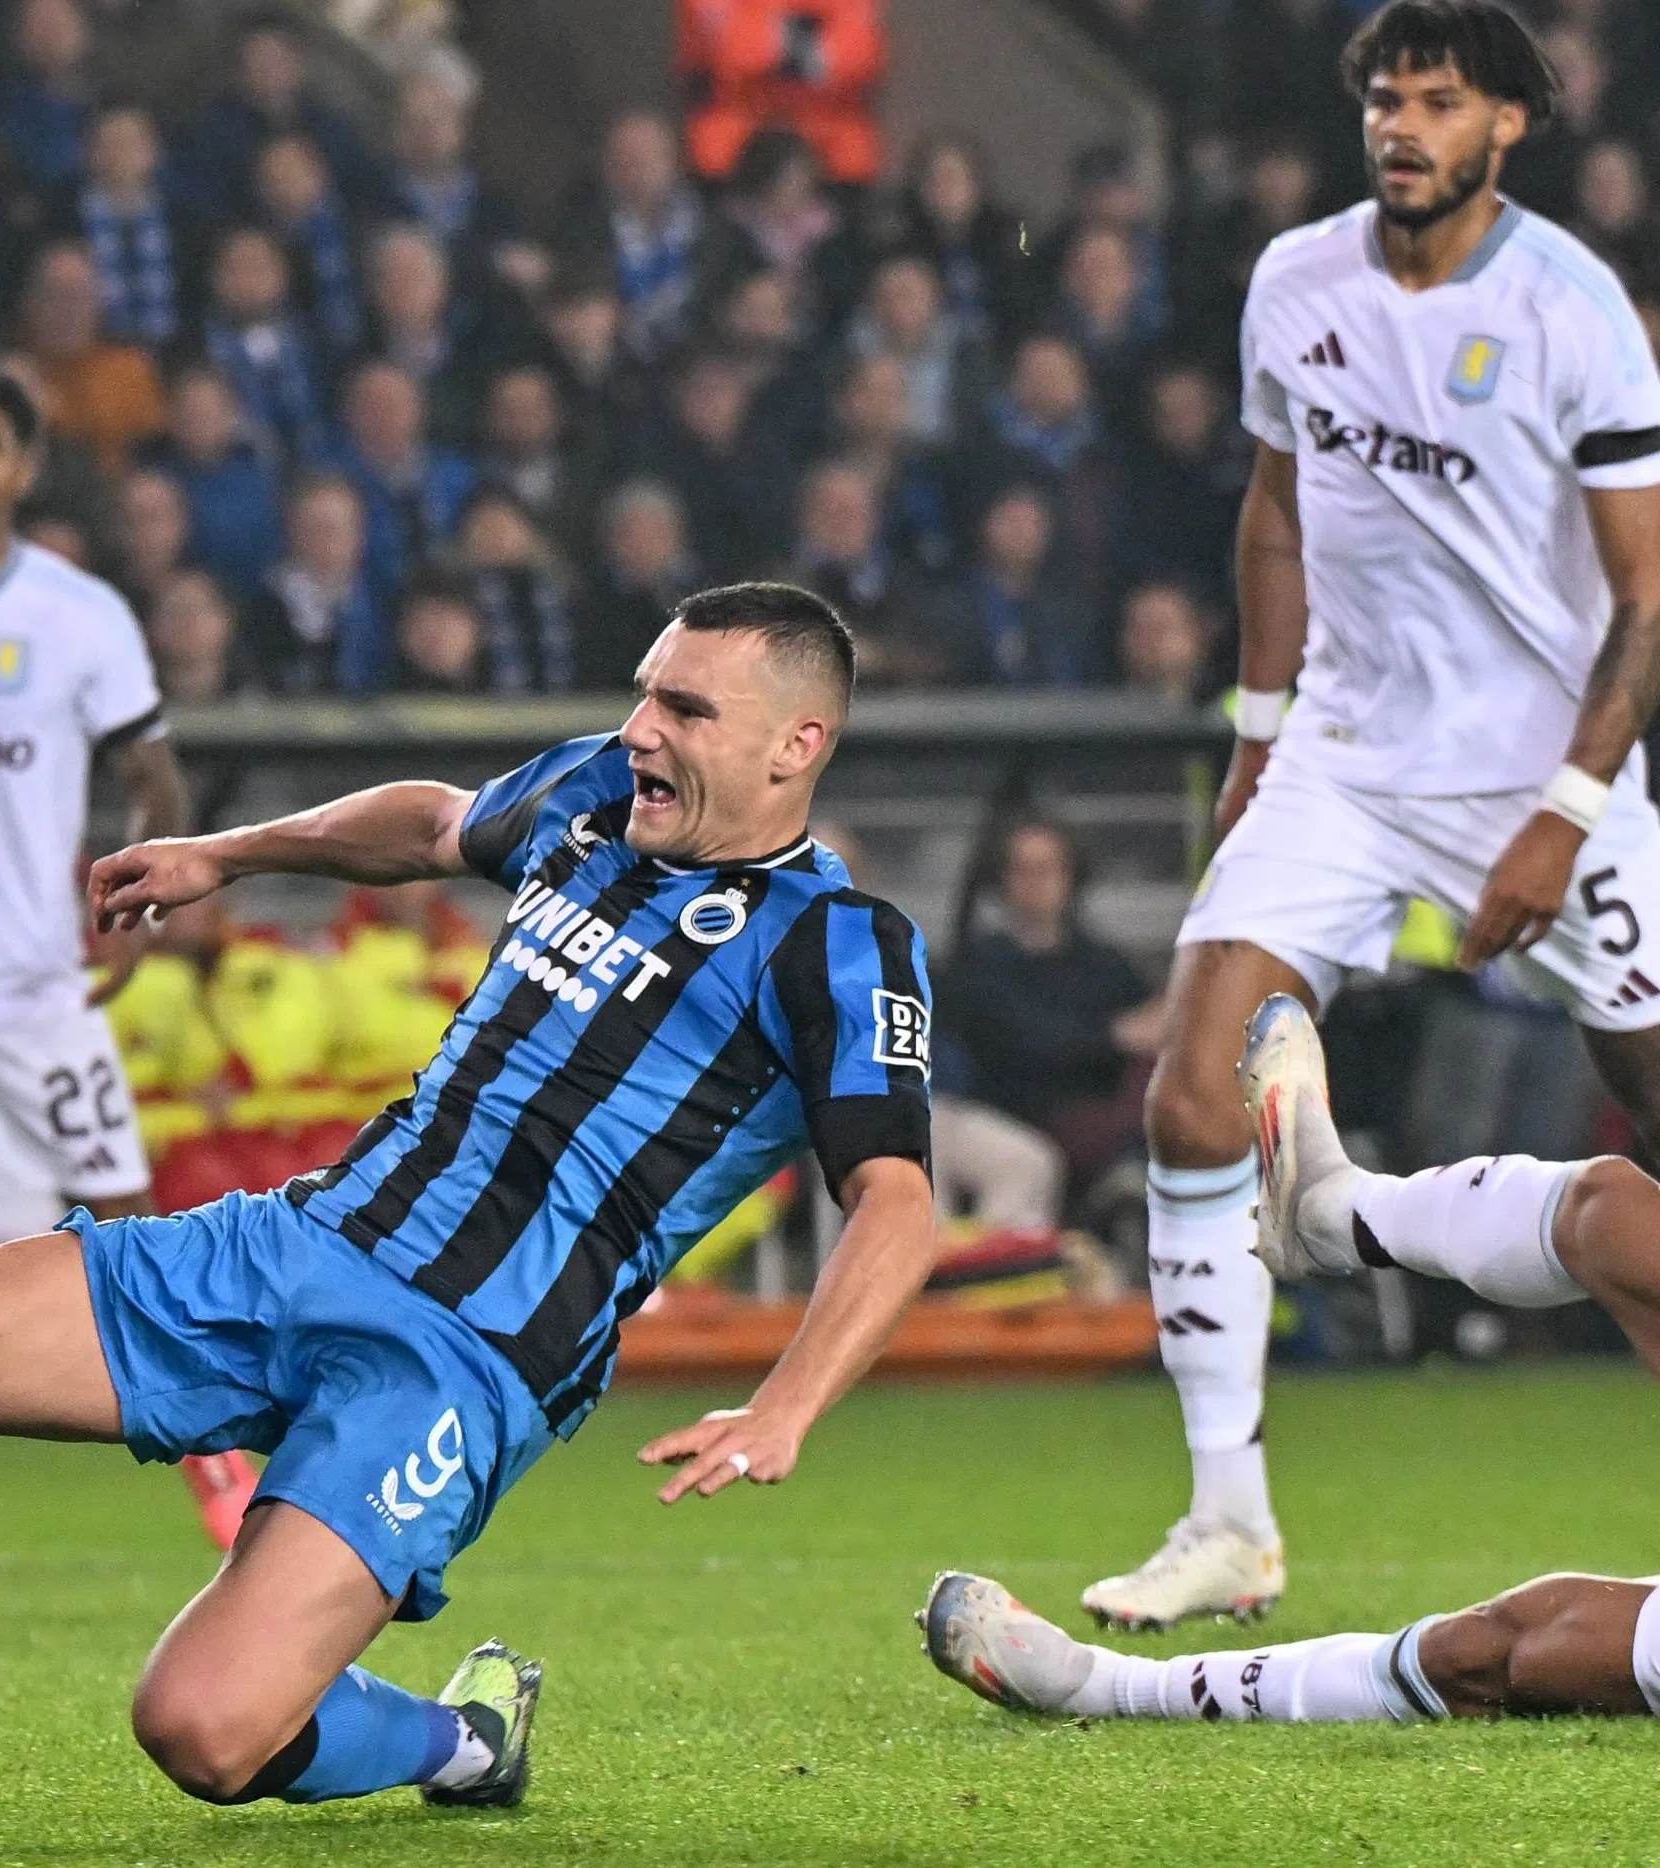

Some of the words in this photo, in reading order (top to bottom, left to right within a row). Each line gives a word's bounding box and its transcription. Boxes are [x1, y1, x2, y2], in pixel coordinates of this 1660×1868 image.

[506, 879, 672, 1003] UNIBET
[1579, 866, 1641, 957] 5
[42, 1056, 127, 1138] 22
[405, 1407, 462, 1498] 9
[1240, 1653, 1271, 1721] 187
